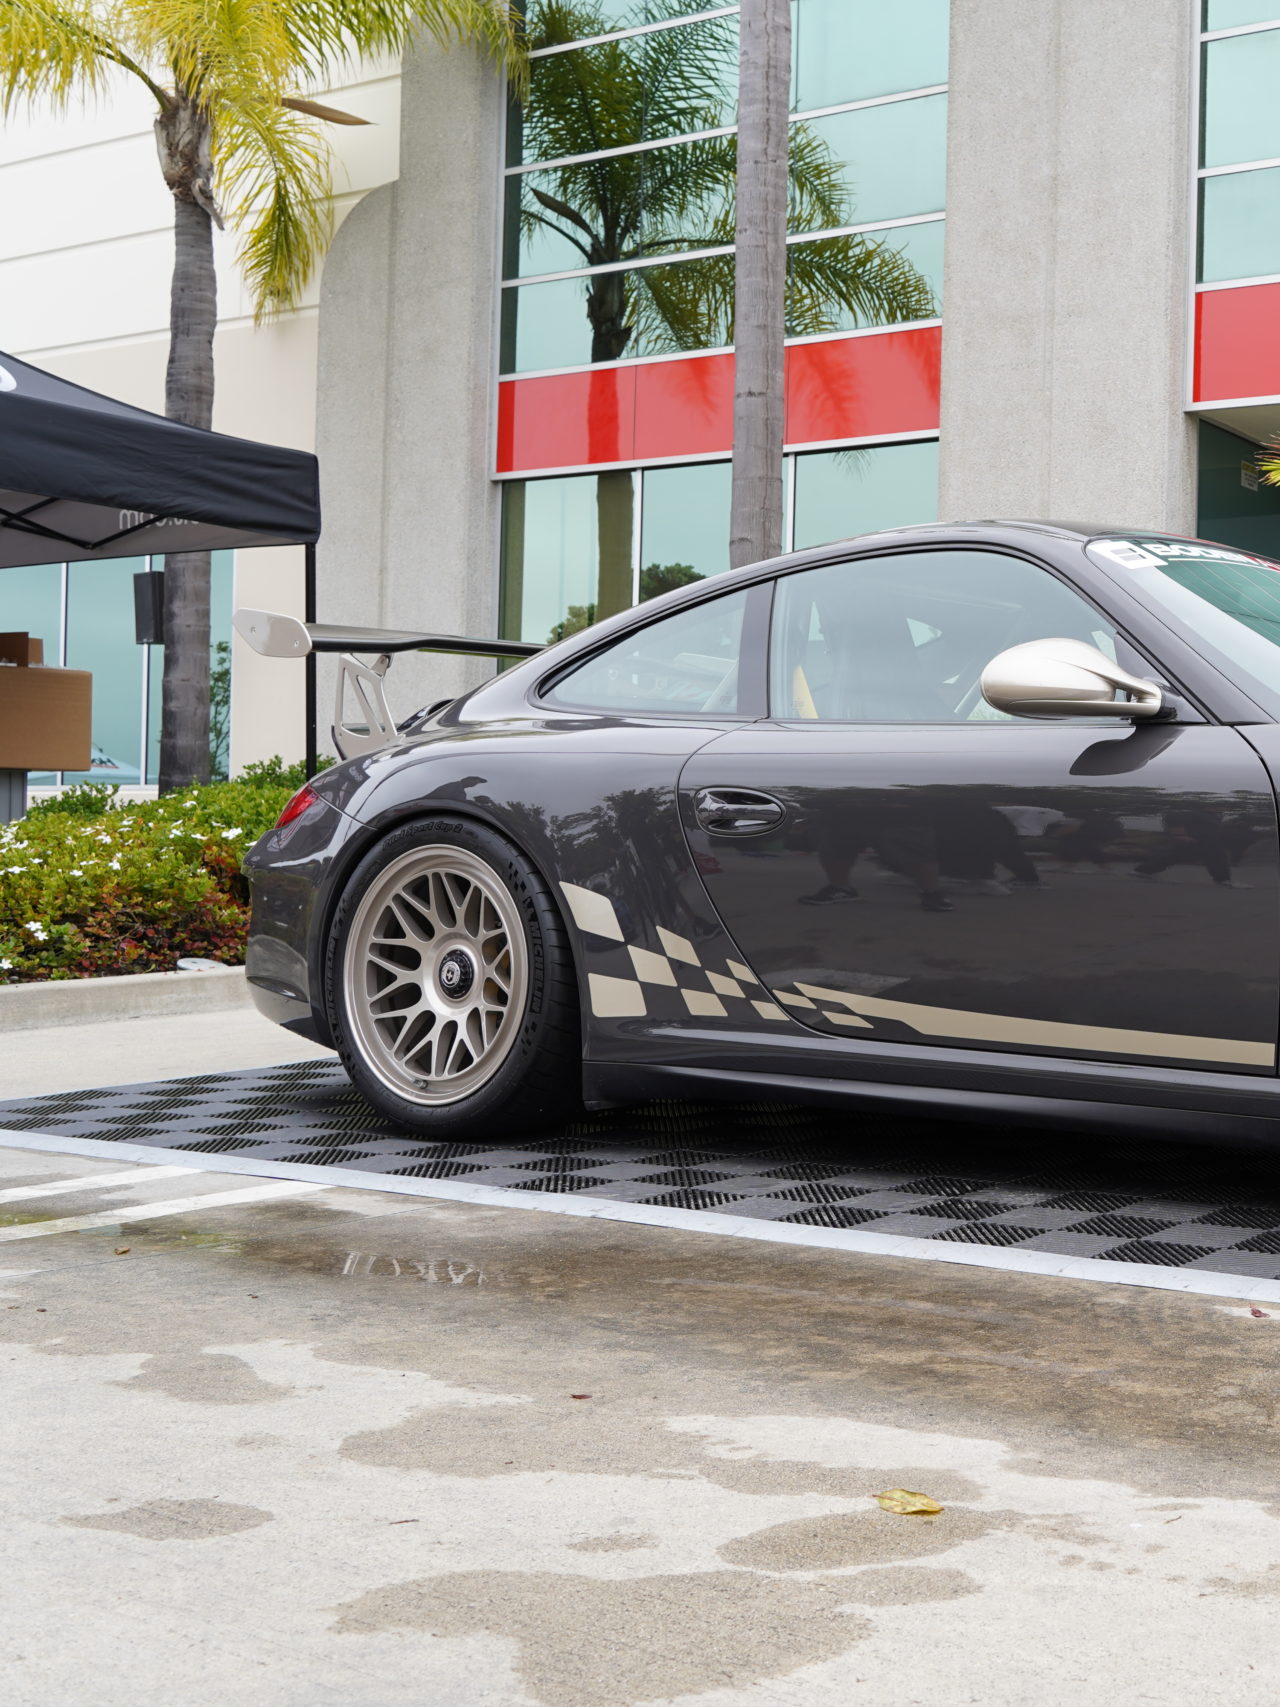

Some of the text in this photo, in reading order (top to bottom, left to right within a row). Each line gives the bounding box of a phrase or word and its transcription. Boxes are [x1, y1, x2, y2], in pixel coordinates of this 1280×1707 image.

[434, 820, 453, 833] Cup
[453, 823, 464, 834] 2
[528, 920, 543, 1013] MICHELIN
